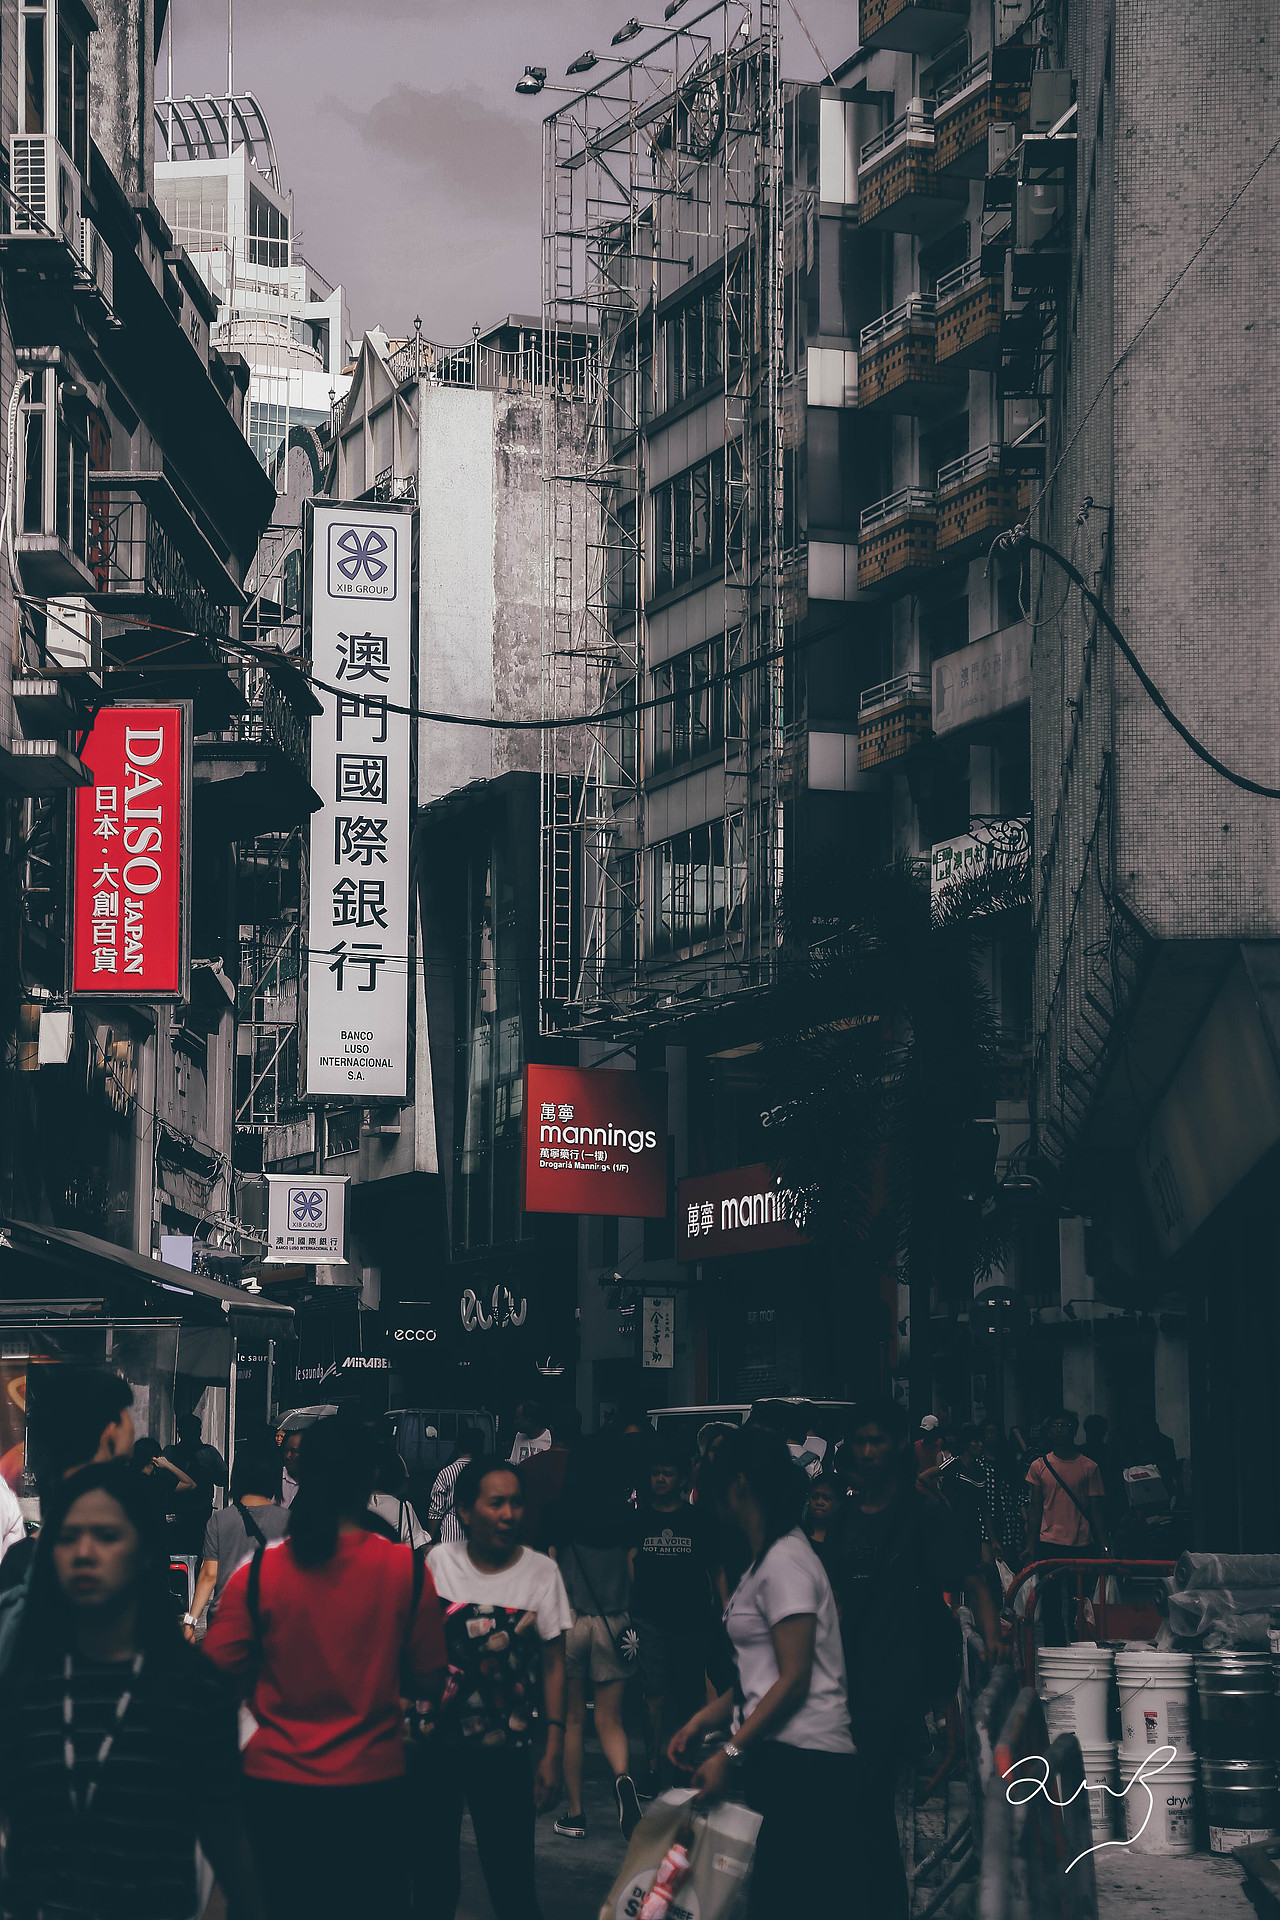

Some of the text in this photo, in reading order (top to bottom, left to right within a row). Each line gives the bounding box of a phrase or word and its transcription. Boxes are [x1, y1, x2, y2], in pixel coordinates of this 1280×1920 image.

[336, 583, 389, 595] XIB GROUP
[329, 631, 390, 993] 澳門國際銀行
[123, 726, 165, 977] DAISO JAPAN
[340, 1030, 374, 1041] BANCO
[344, 1044, 370, 1054] LUSO
[319, 1057, 394, 1068] INTERNACIONAL
[347, 1071, 365, 1081] S.A.
[540, 1101, 575, 1123] 萬寧
[540, 1122, 657, 1154] mannings
[612, 1164, 629, 1174] (1/F)
[687, 1200, 714, 1239] 萬寧
[394, 1329, 437, 1341] ecco
[295, 1363, 324, 1381] le saunda
[665, 1538, 691, 1546] VOICE
